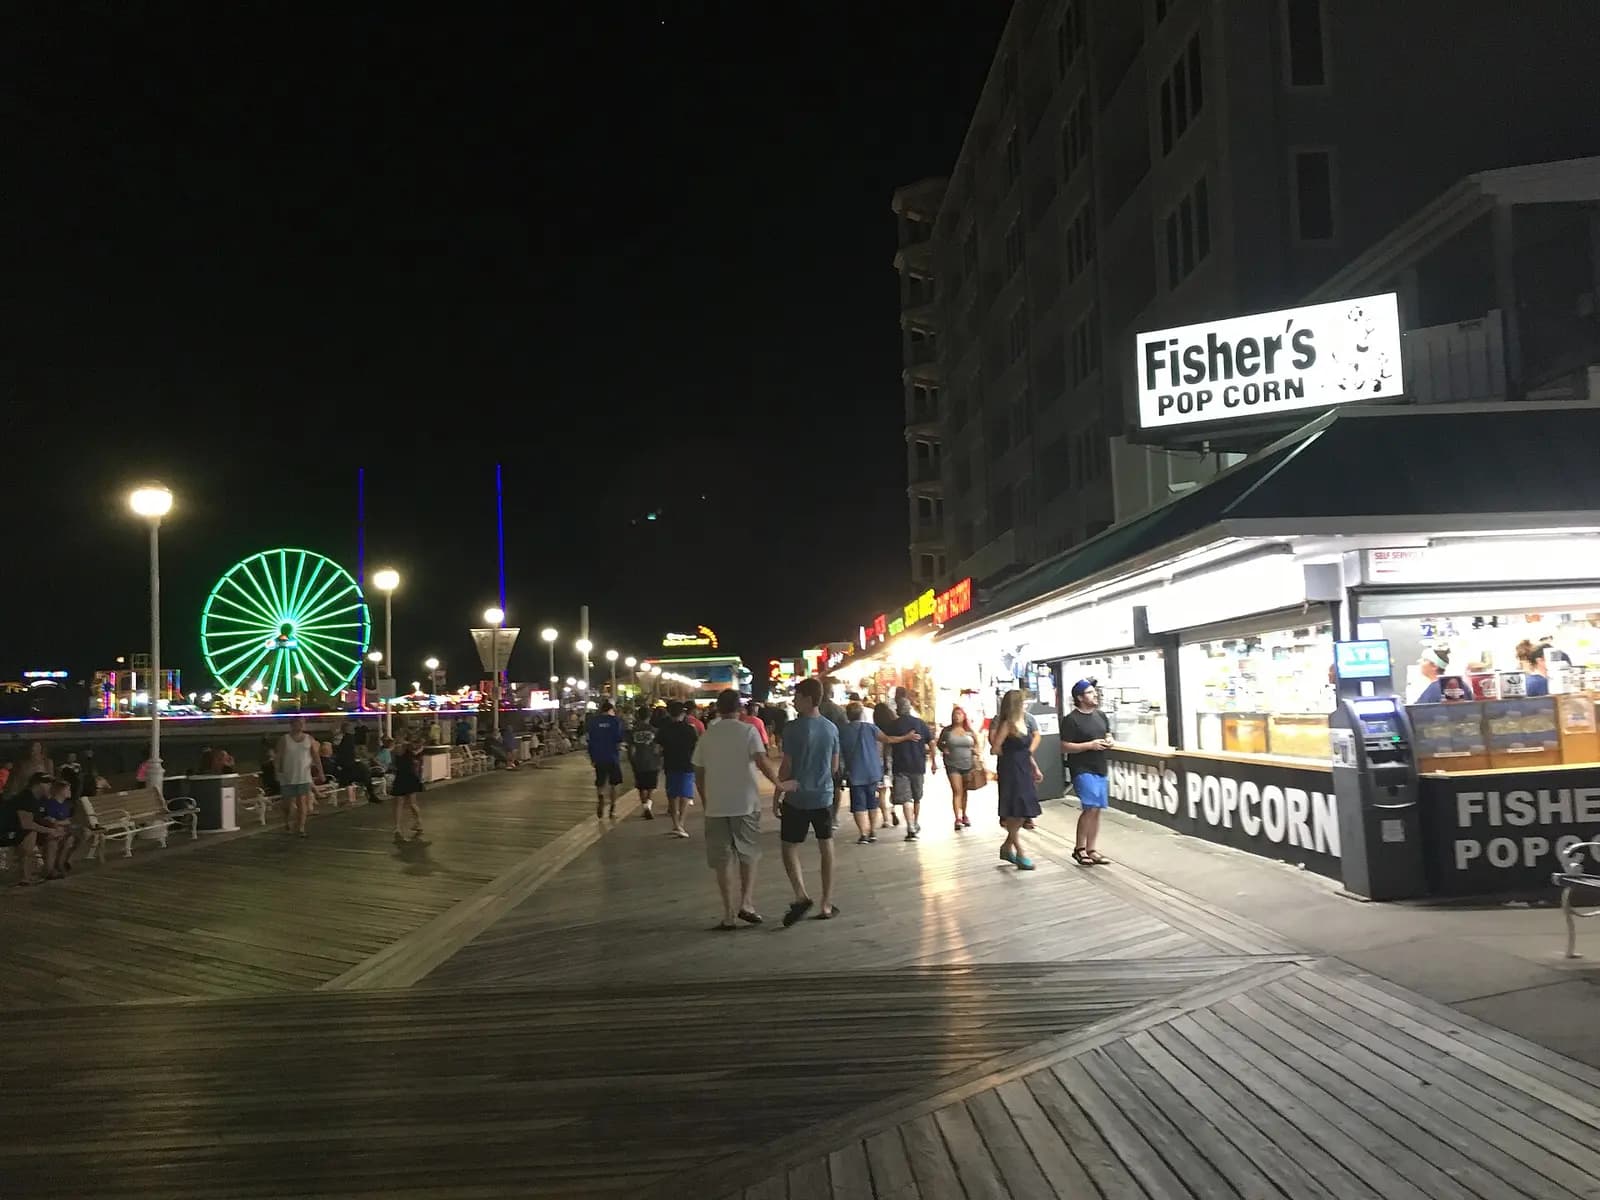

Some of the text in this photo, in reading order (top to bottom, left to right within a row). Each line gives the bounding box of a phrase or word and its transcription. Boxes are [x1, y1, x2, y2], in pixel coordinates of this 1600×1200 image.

[1145, 319, 1317, 390] Fisher's
[1158, 377, 1305, 416] POP CORN
[1106, 759, 1342, 858] ISHER'S POPCORN
[1455, 787, 1600, 828] FISHE
